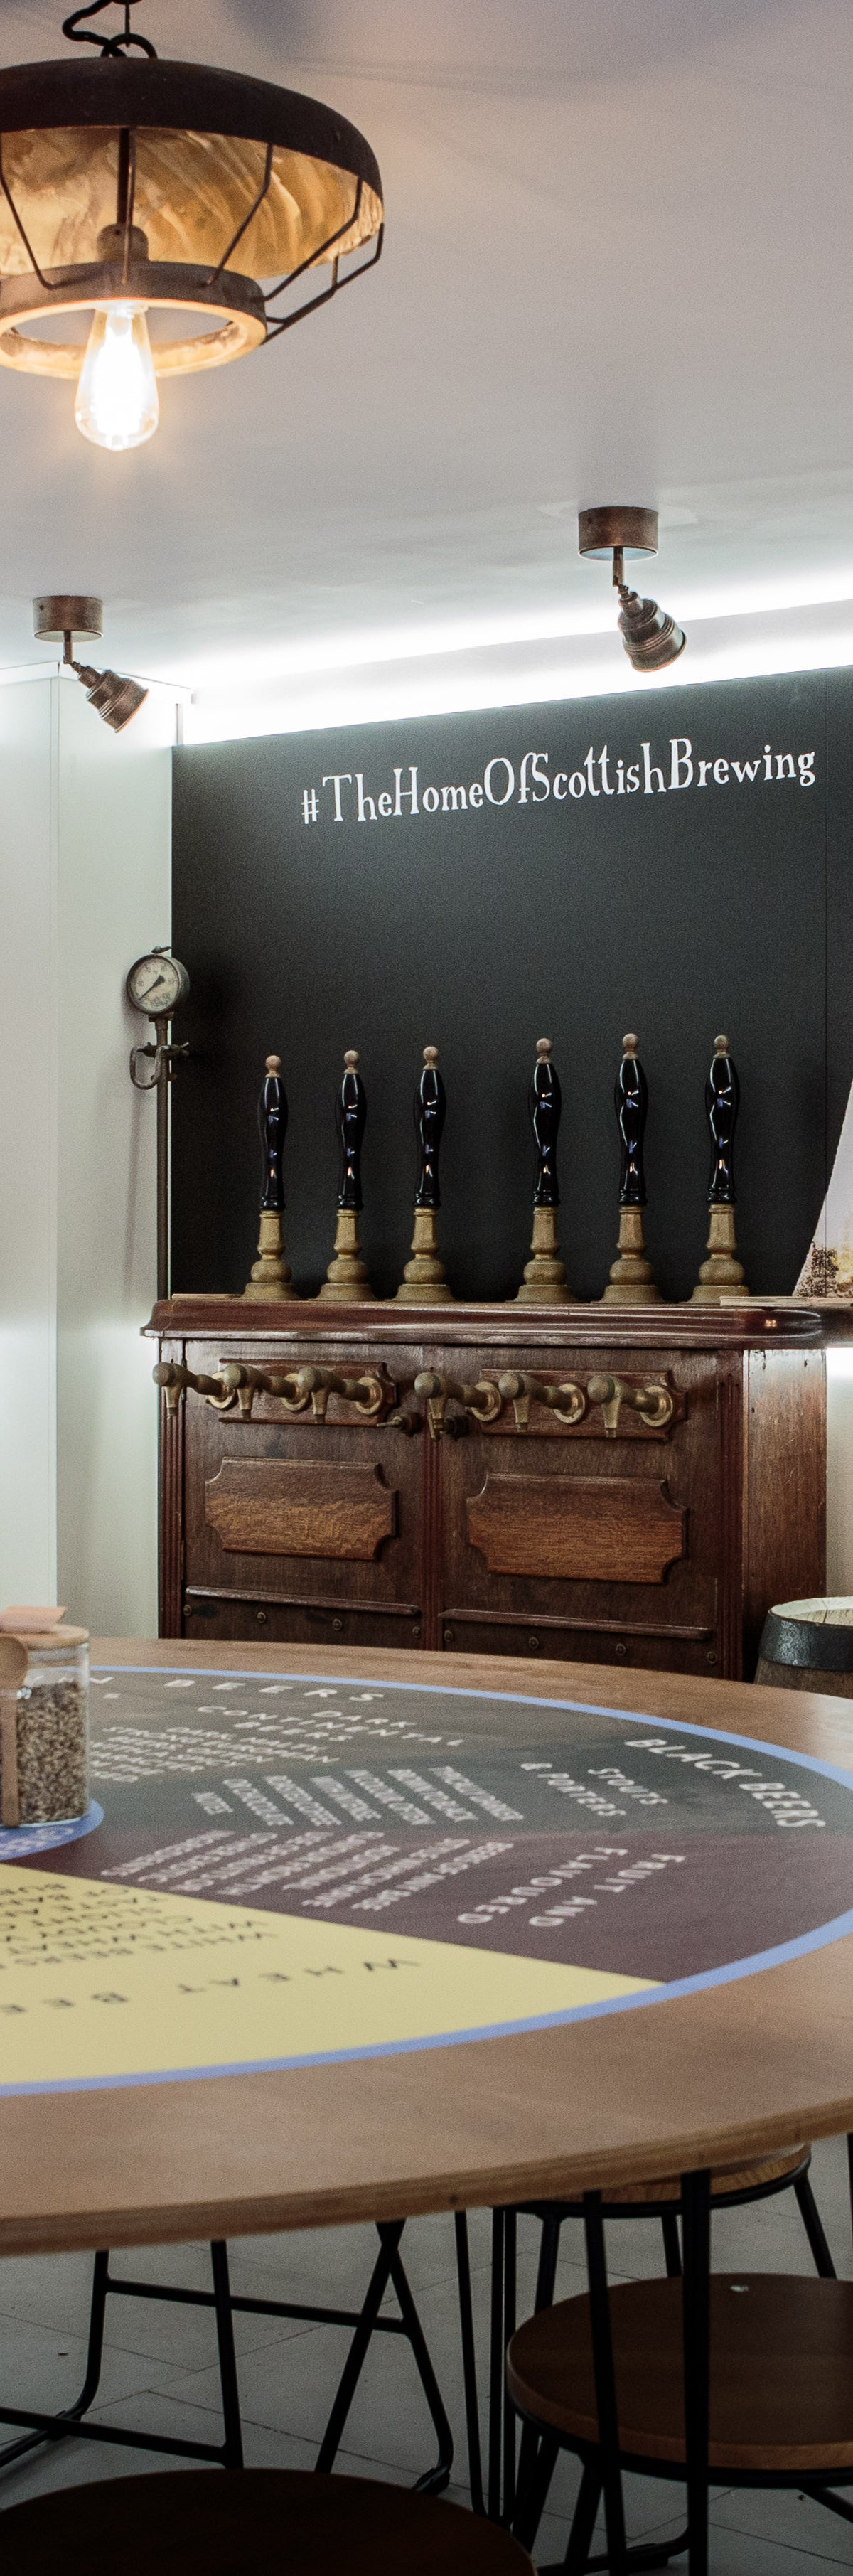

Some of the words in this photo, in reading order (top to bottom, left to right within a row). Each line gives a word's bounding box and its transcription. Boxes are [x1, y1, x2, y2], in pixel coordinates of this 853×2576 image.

[164, 1679, 385, 1701] BEERS
[197, 1706, 465, 1747] CONTINENTAL
[233, 1721, 353, 1741] BEERS
[311, 1711, 416, 1728] DARK
[538, 1773, 627, 1817] PORTERS
[588, 1768, 667, 1805] STOUTS
[625, 1738, 762, 1779] BLACK
[739, 1783, 826, 1828] BEERS
[457, 1847, 628, 1925] FLAVOURED
[593, 1853, 686, 1893] FRUIT
[529, 1896, 598, 1928] AND
[176, 1957, 419, 1993] WHEAT
